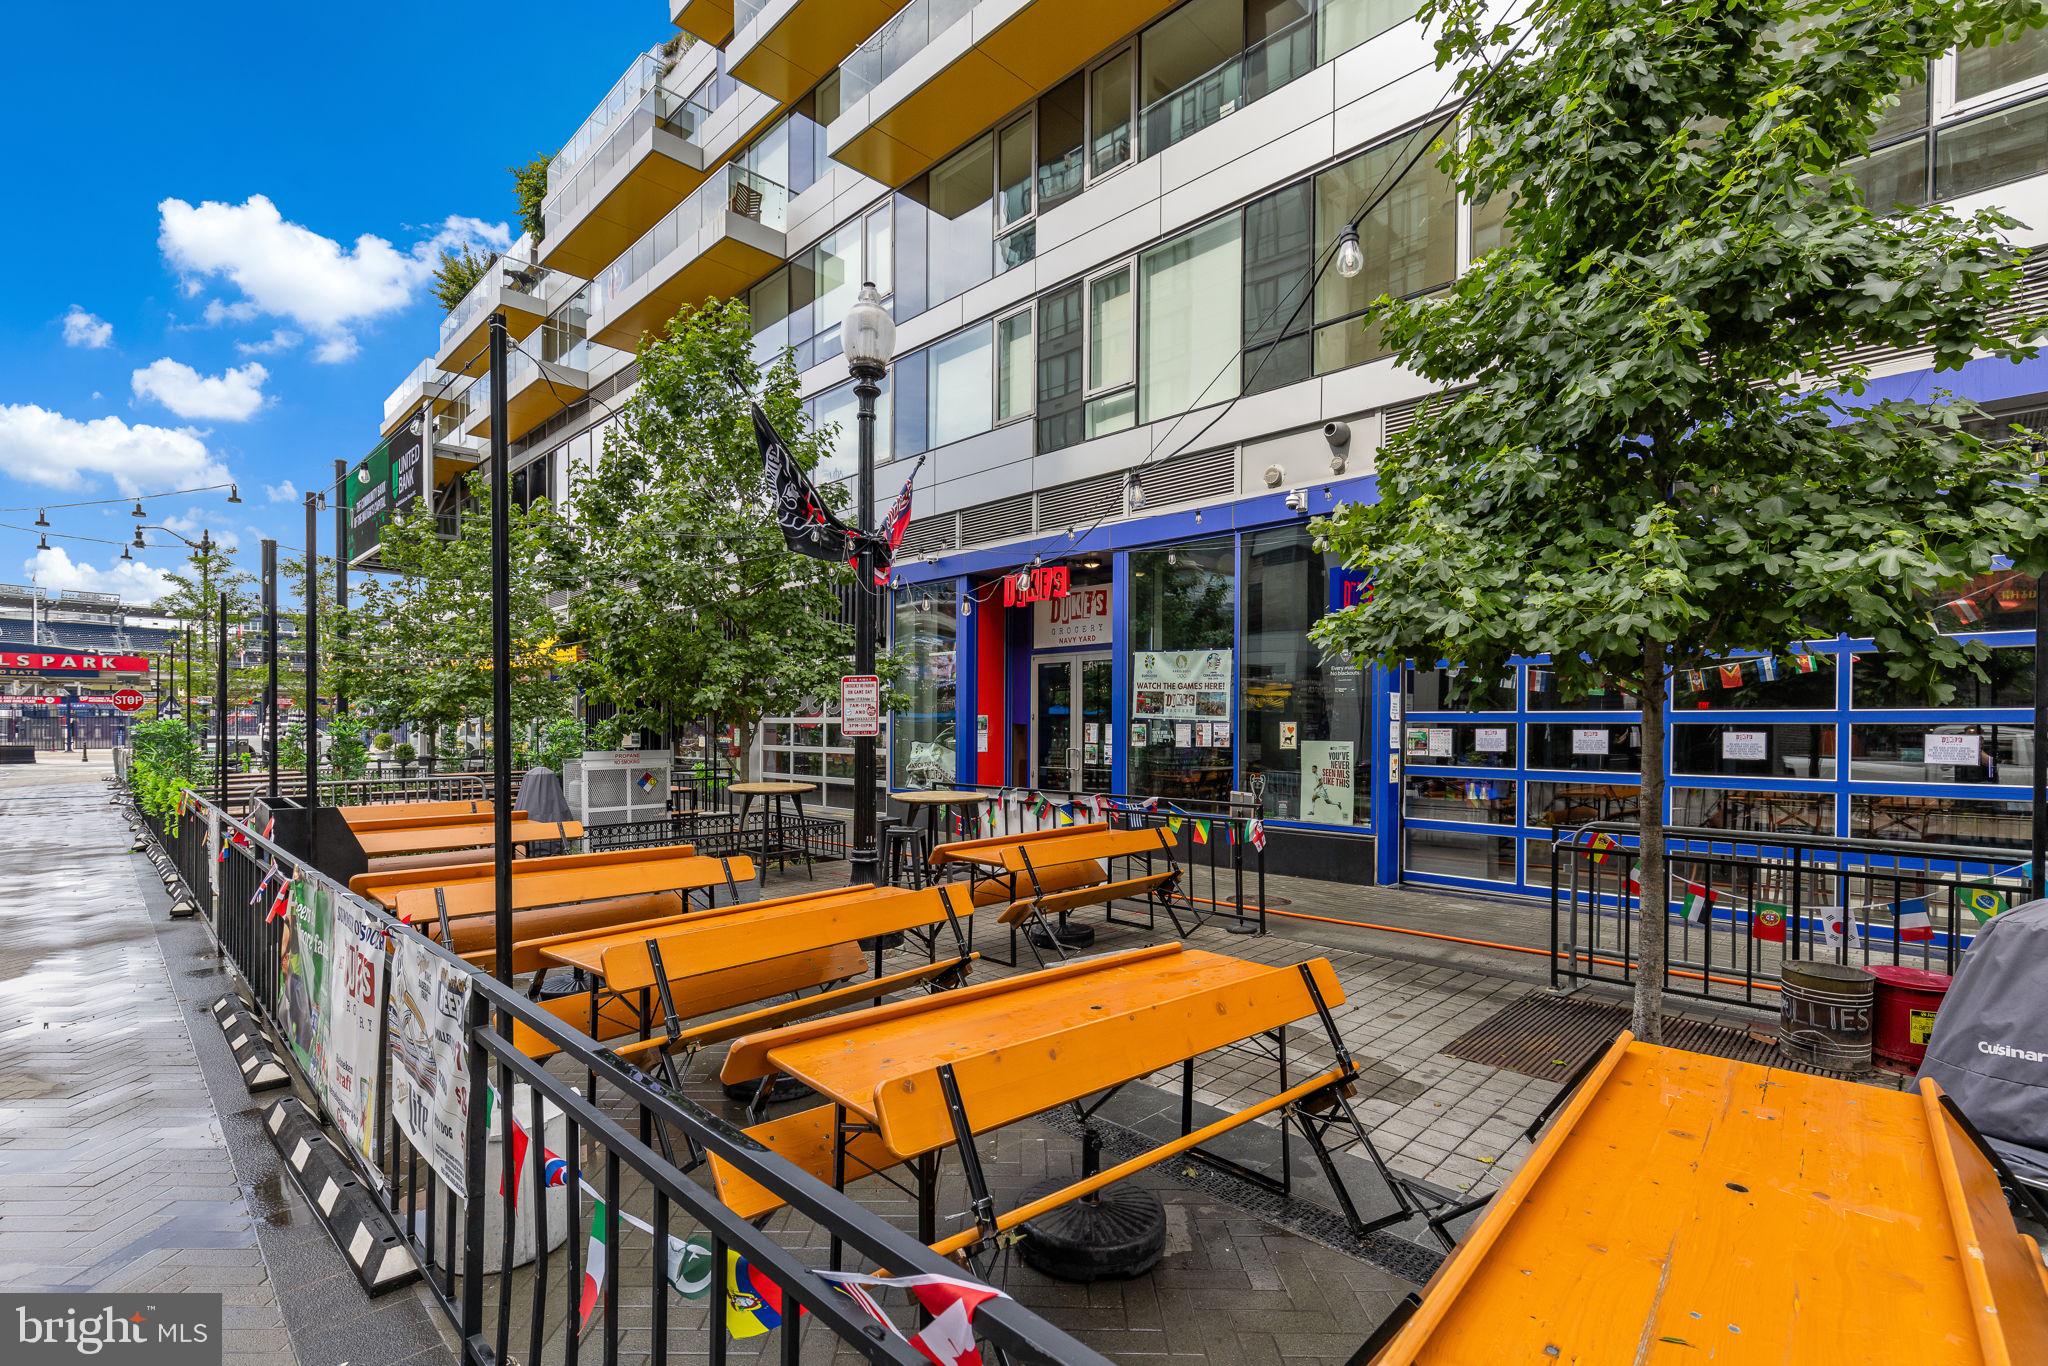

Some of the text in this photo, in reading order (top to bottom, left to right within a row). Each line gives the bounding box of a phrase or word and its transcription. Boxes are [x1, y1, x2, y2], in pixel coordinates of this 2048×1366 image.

[398, 444, 420, 475] UNITED
[398, 467, 415, 495] BANK
[1050, 589, 1107, 624] DUKE'S
[1051, 623, 1103, 636] GROCERY
[1058, 635, 1096, 645] NAVY YARD
[41, 655, 117, 669] PARK
[1136, 682, 1225, 690] WATCH THE GAMES HERE!
[114, 695, 143, 705] STOP
[1328, 752, 1350, 760] YOU'VE
[1330, 761, 1350, 769] NEVER
[1322, 768, 1350, 779] SEEN MLS
[1322, 778, 1350, 788] LIKE THIS
[1977, 1041, 2048, 1063] Cuisinar
[335, 1065, 352, 1093] Draft
[440, 1123, 454, 1140] DOG
